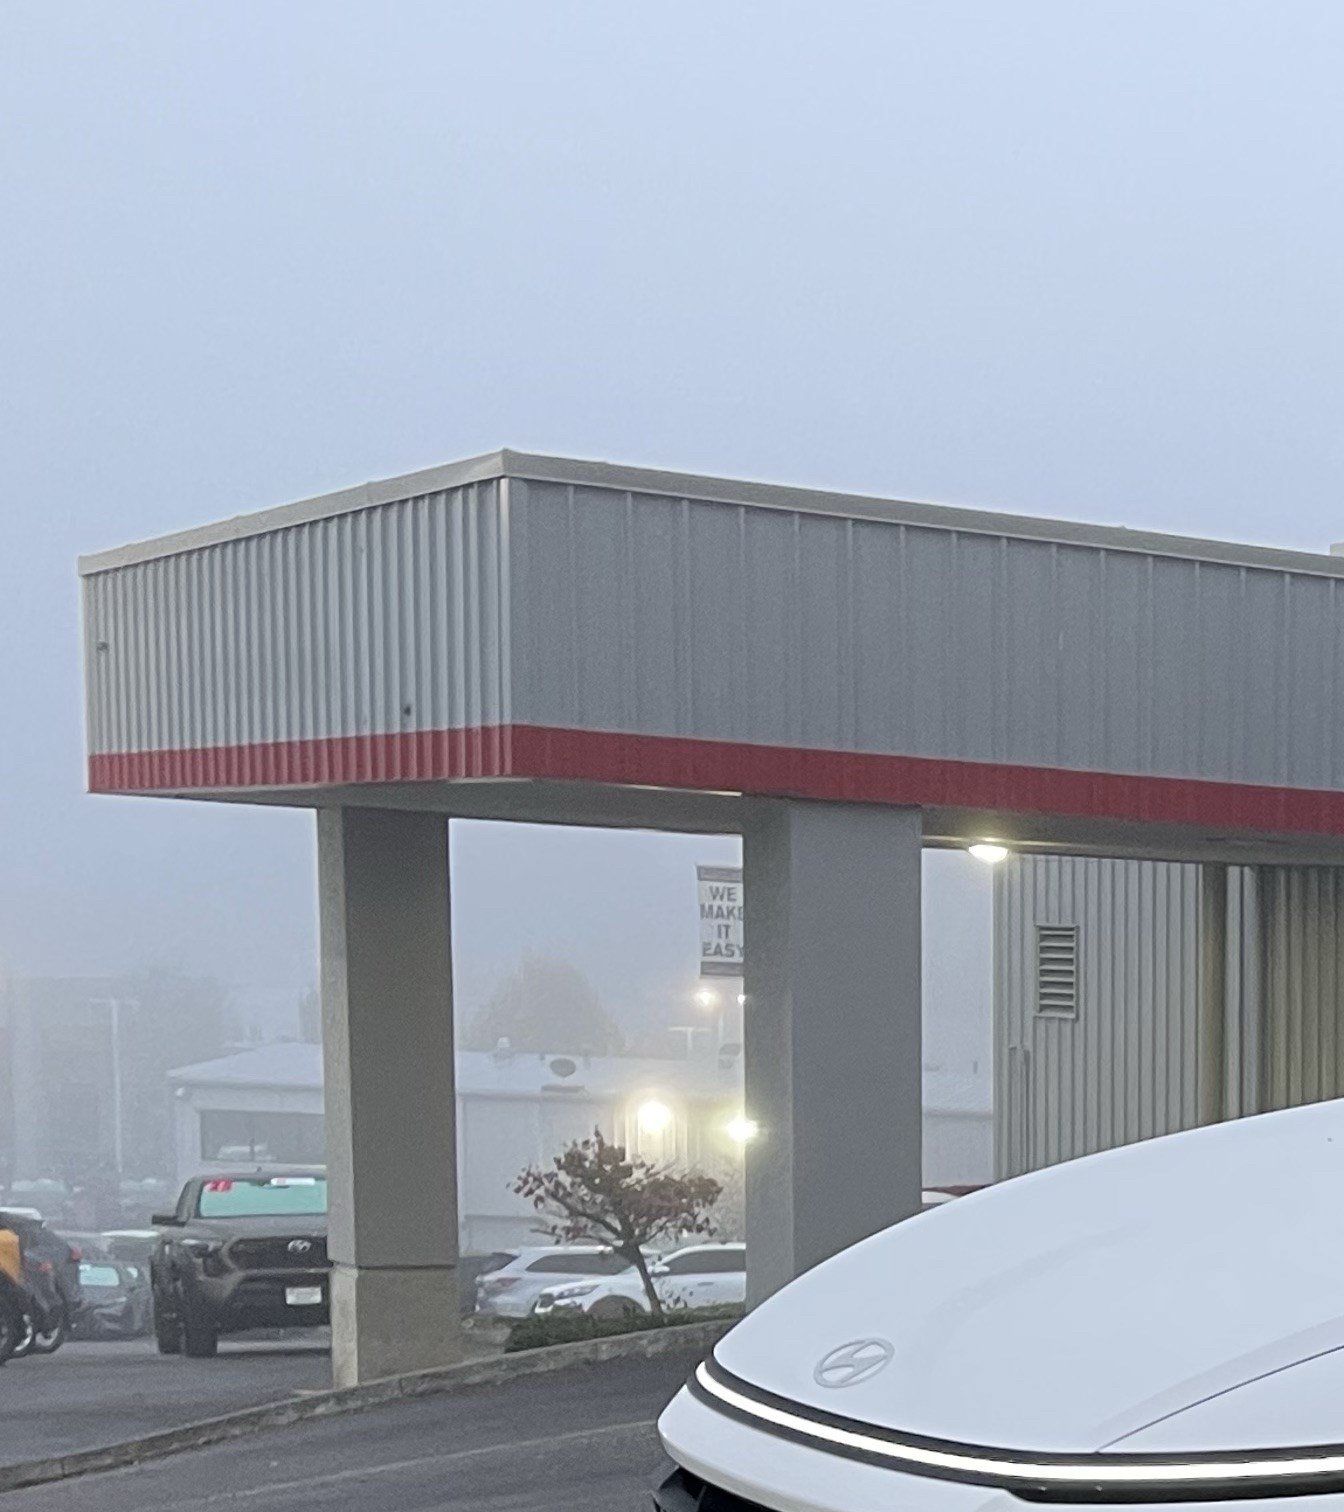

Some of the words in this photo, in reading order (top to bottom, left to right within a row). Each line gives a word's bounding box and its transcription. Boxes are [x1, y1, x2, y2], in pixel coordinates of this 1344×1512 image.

[708, 885, 737, 902] WE
[699, 903, 743, 921] MAKE
[717, 924, 731, 939] IT
[701, 941, 743, 958] EASY
